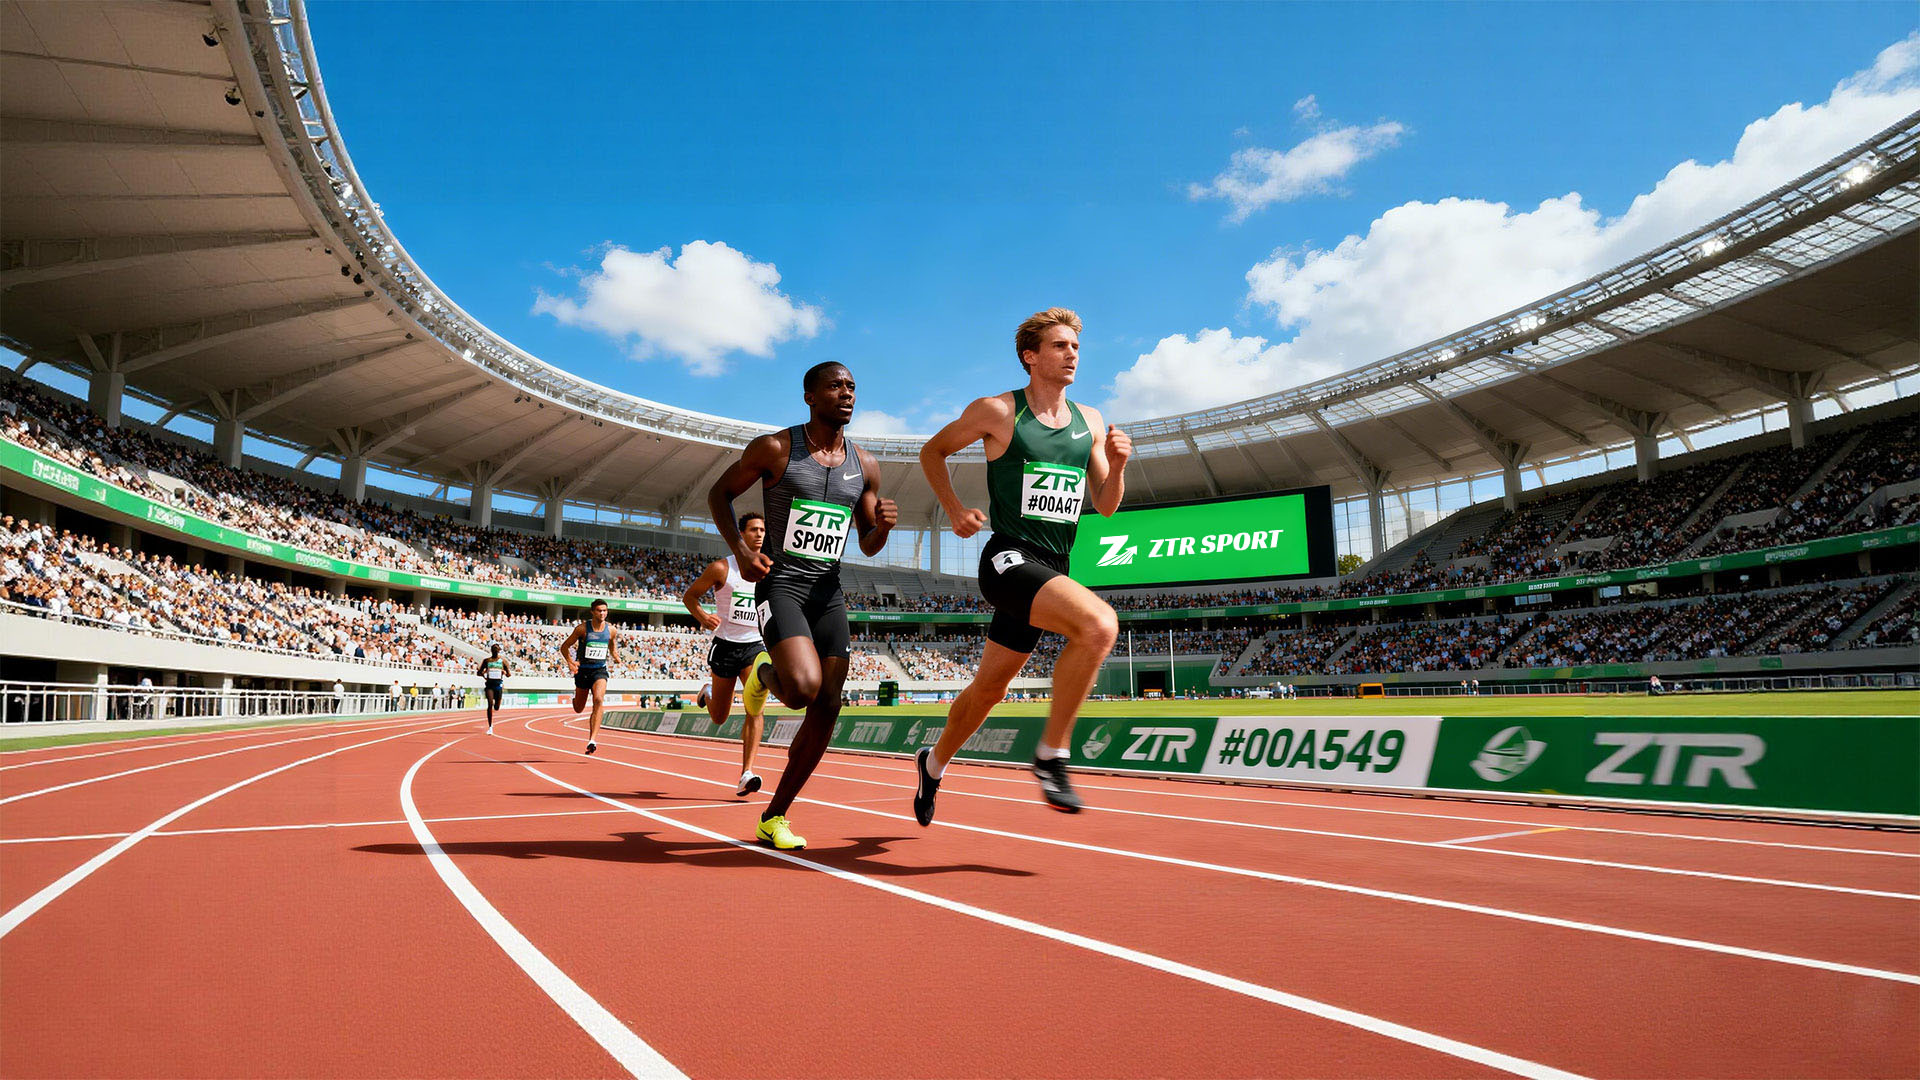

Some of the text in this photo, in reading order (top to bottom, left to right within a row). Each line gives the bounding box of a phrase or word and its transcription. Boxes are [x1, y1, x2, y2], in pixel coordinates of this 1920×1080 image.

[1030, 470, 1081, 493] ZTR
[795, 507, 846, 531] ZTR
[791, 529, 843, 554] SPORT
[1148, 529, 1284, 558] ZTR SPORT
[1121, 727, 1405, 773] ZTR #00A549
[1585, 732, 1766, 789] ZTR
